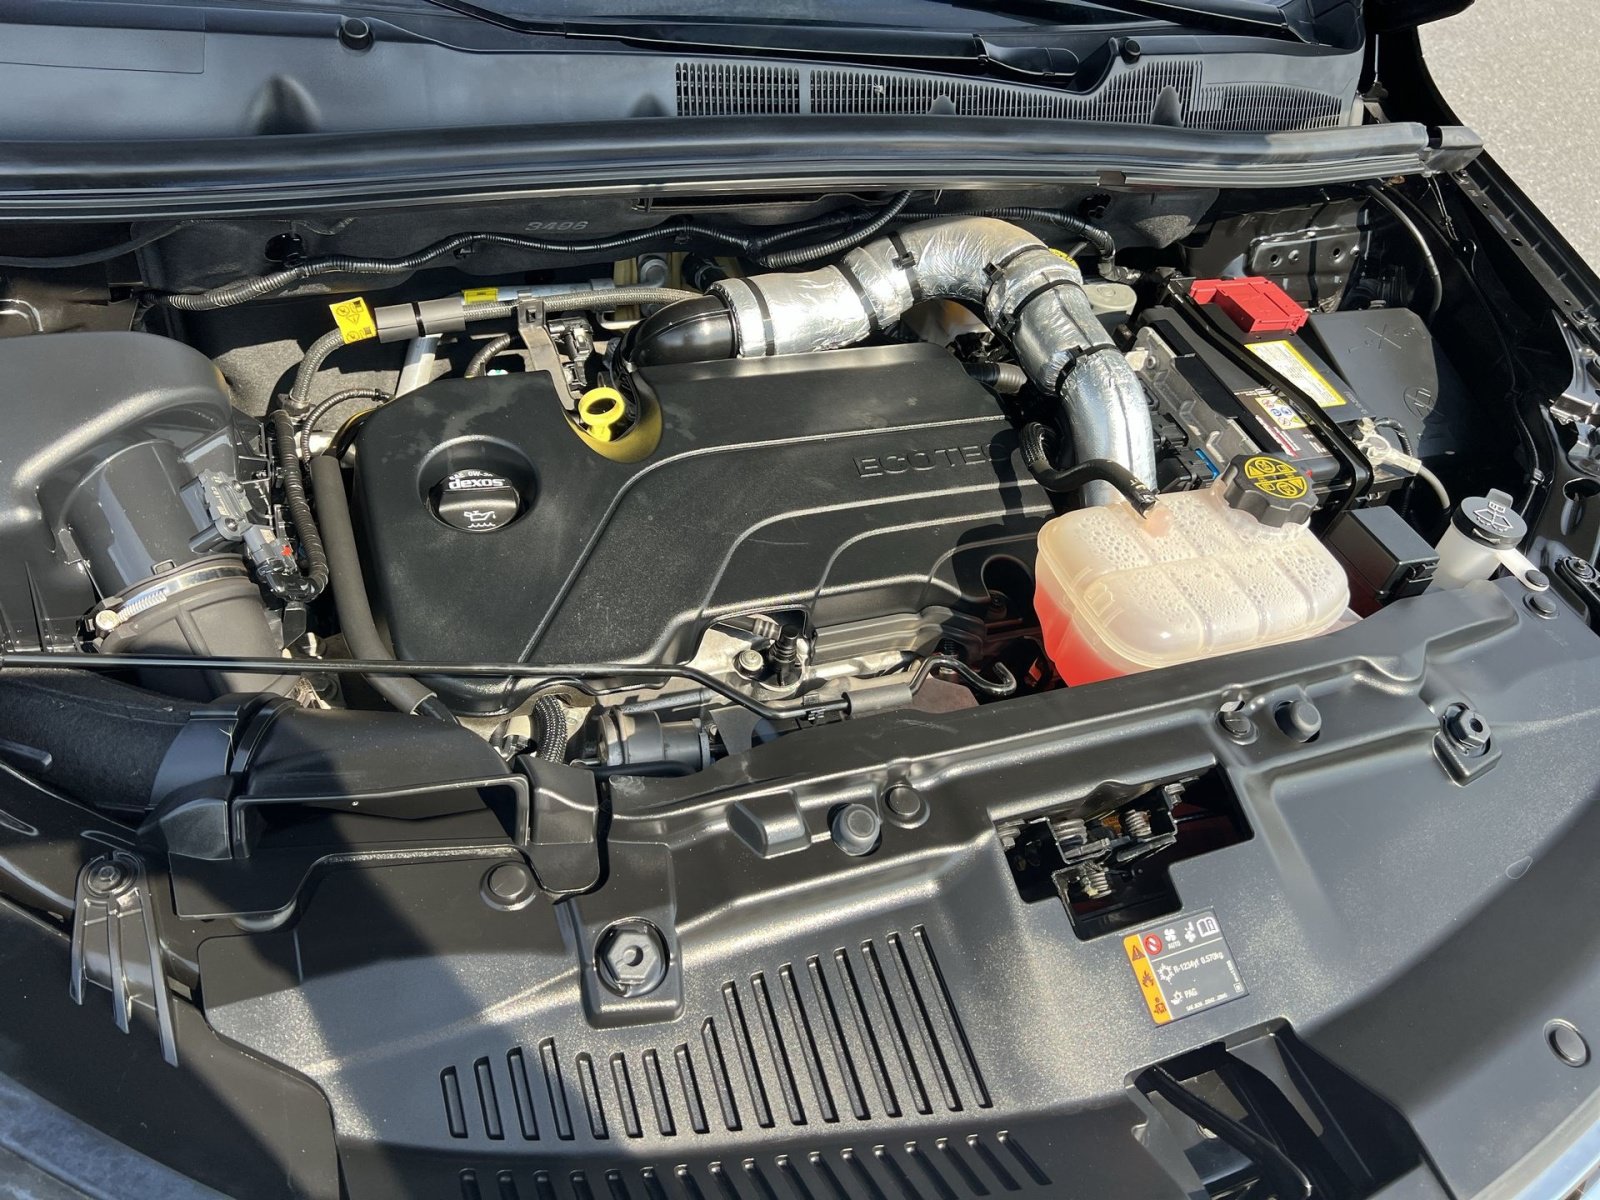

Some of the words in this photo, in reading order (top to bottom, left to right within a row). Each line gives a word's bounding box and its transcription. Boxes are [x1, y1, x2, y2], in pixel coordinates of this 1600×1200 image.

[853, 443, 1008, 478] ECOTEC
[449, 478, 506, 489] dexos
[1183, 987, 1198, 999] PAG
